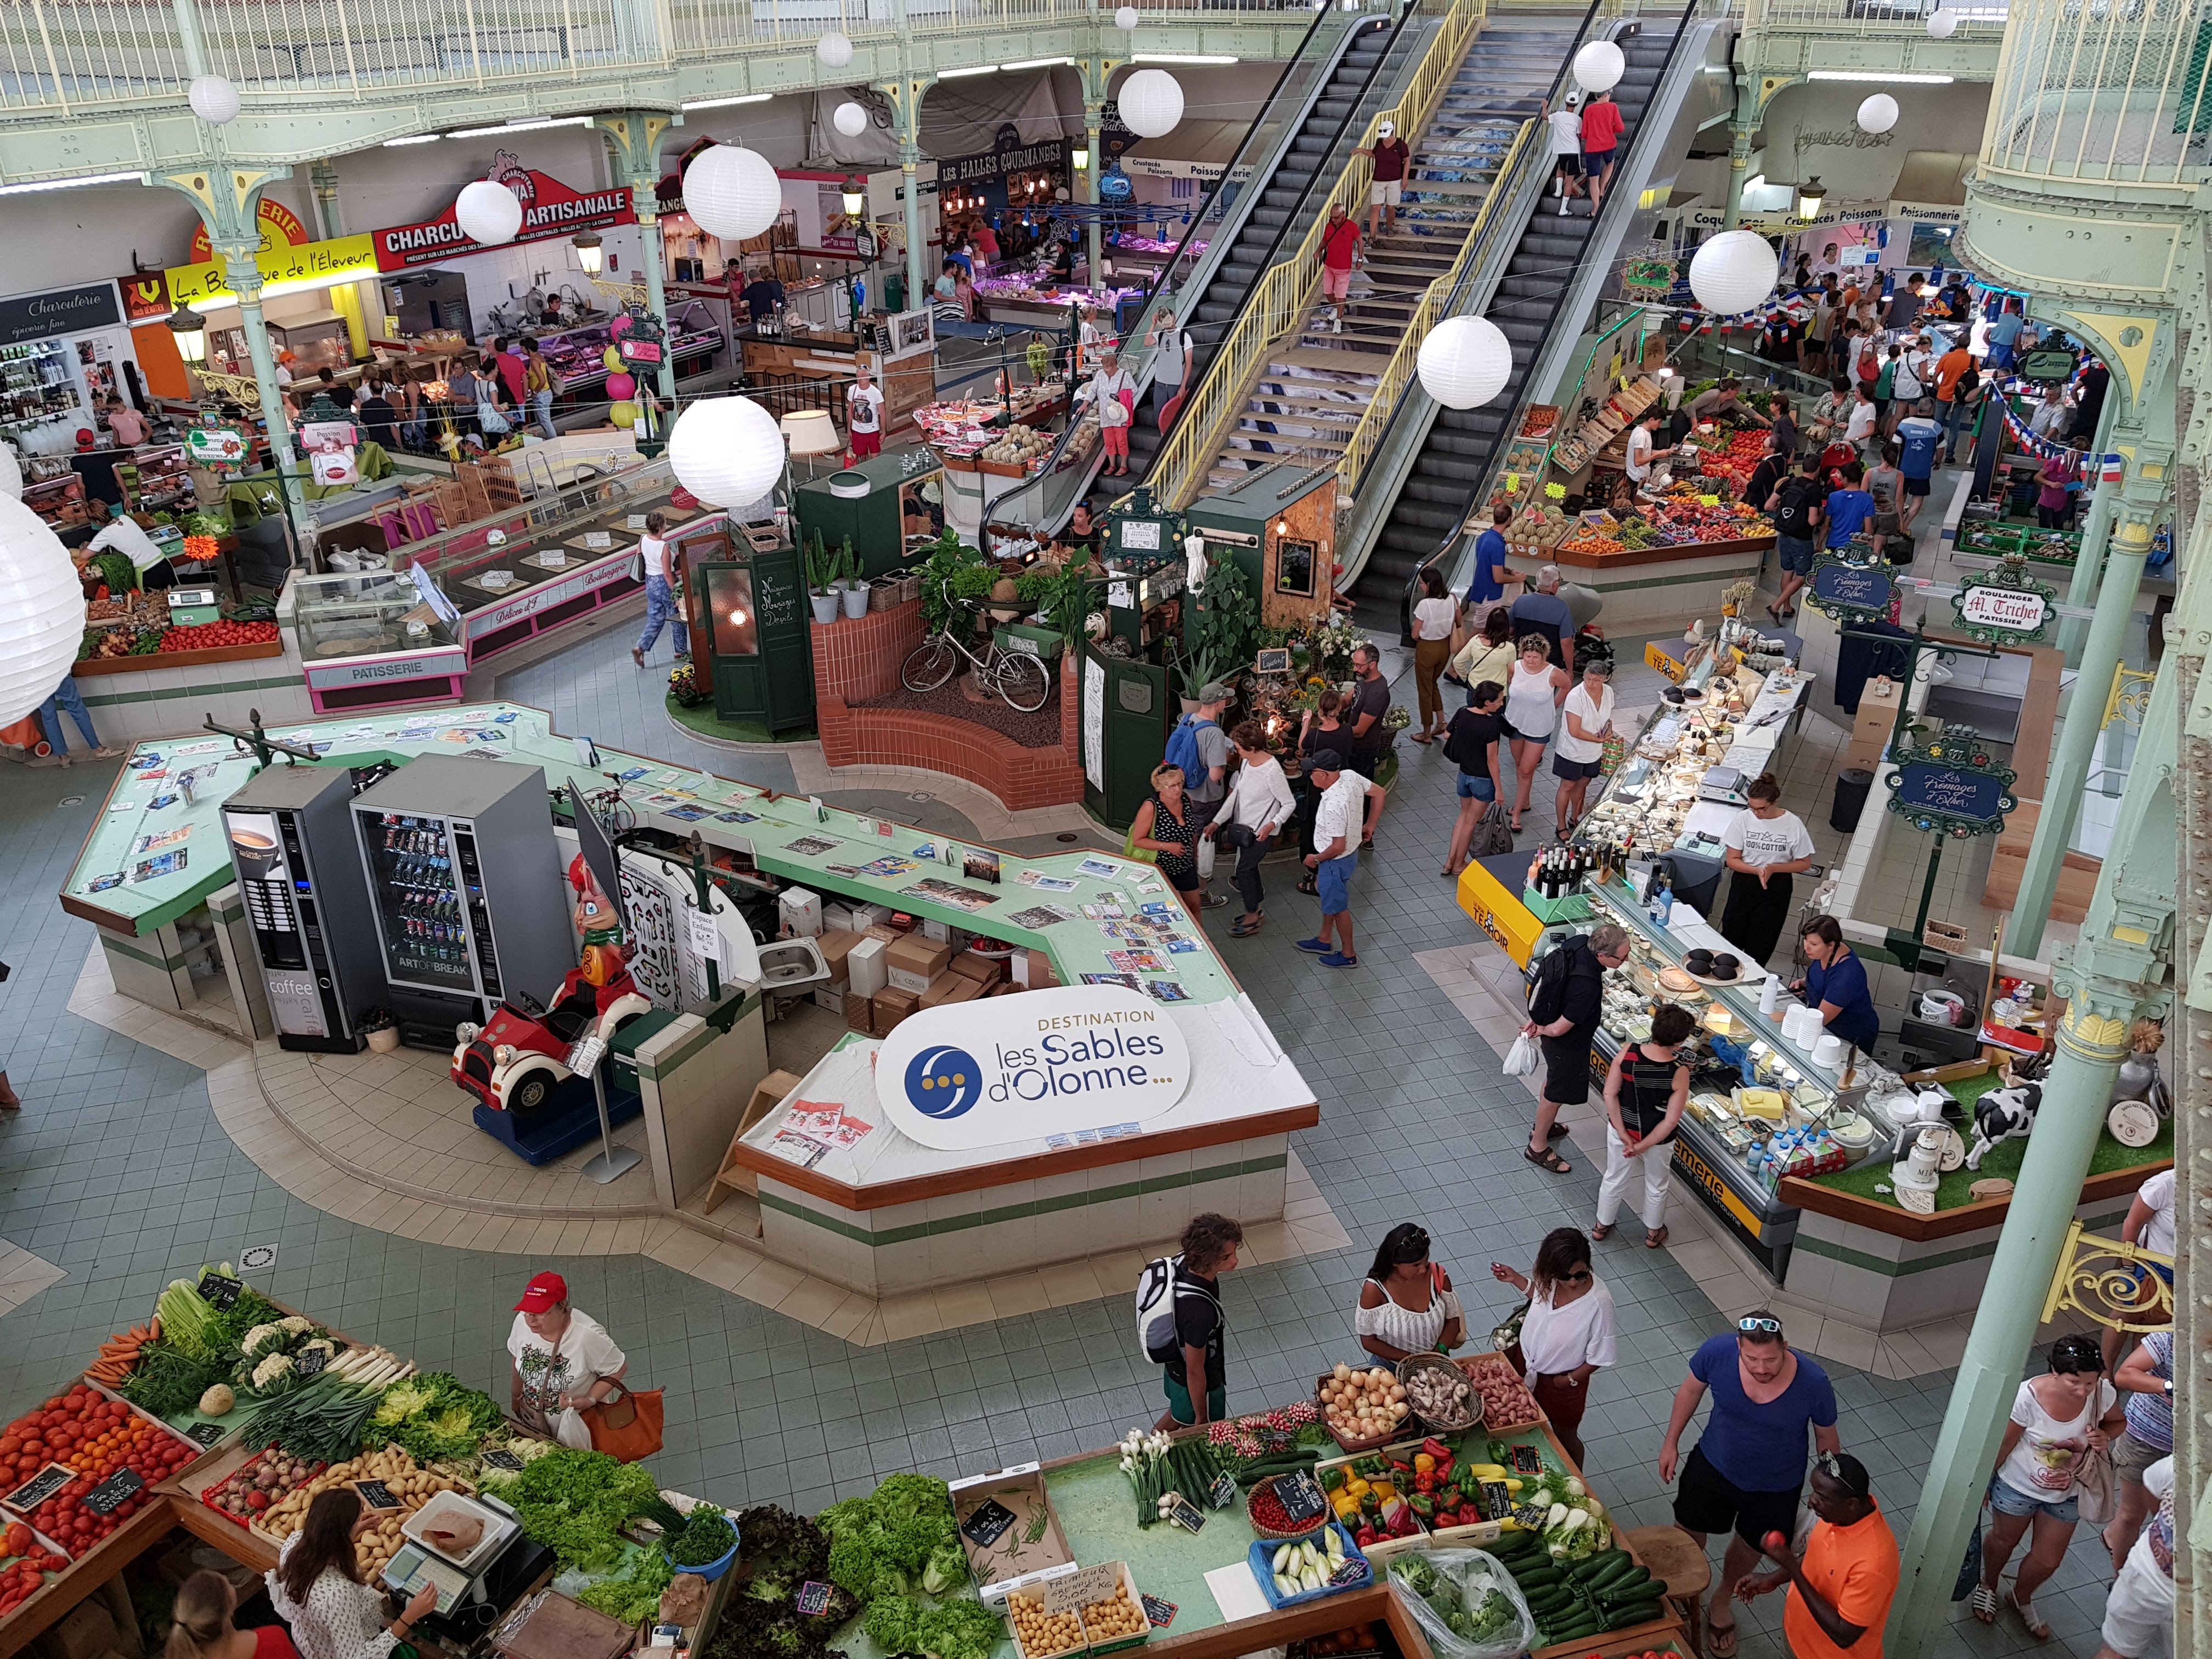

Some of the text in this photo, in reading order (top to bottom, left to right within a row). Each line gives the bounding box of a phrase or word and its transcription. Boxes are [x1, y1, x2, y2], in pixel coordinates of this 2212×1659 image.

[943, 143, 1061, 182] LES HALLES GOURMANDES
[1132, 159, 1161, 167] Crustacés
[502, 169, 534, 198] CHARCUTERIE
[917, 180, 936, 190] PARKING
[386, 222, 464, 252] CHARCU
[526, 192, 625, 227] ARTISANALE
[1785, 213, 1835, 227] Cruacés
[1839, 207, 1882, 222] Poissons
[1901, 205, 1961, 221] Poissonnerie
[445, 245, 467, 256] MARCHÉS
[535, 227, 559, 238] CENTRALES
[561, 224, 575, 233] HALLES
[176, 277, 200, 299] La
[286, 255, 304, 278] de
[310, 249, 371, 272] l'Éleveur
[29, 292, 102, 317] Charcuterie
[1833, 573, 1872, 591] Fromages
[1844, 570, 1860, 579] Les
[496, 607, 523, 624] Délices
[585, 562, 628, 586] Boulangerie
[1979, 590, 2033, 602] BOULANGER
[761, 594, 795, 611] Mariages
[1993, 599, 2040, 620] Trichet
[1979, 614, 2022, 625] PATISSIER
[352, 662, 424, 680] PATISSERIE
[1940, 771, 1961, 783] Les
[1924, 775, 1977, 798] Fromages
[1926, 790, 1968, 807] d'Esther
[1745, 840, 1787, 851] 100% COTTON
[692, 912, 713, 924] Espace
[692, 921, 714, 934] Enfants
[269, 979, 313, 996] coffee
[1038, 1011, 1155, 1031] DESTINATION
[996, 1028, 1164, 1070] les Sables
[1694, 1174, 1702, 1184] de
[1703, 1184, 1711, 1197] la
[1712, 1193, 1742, 1228] Chaume
[1098, 1581, 1113, 1590] KG
